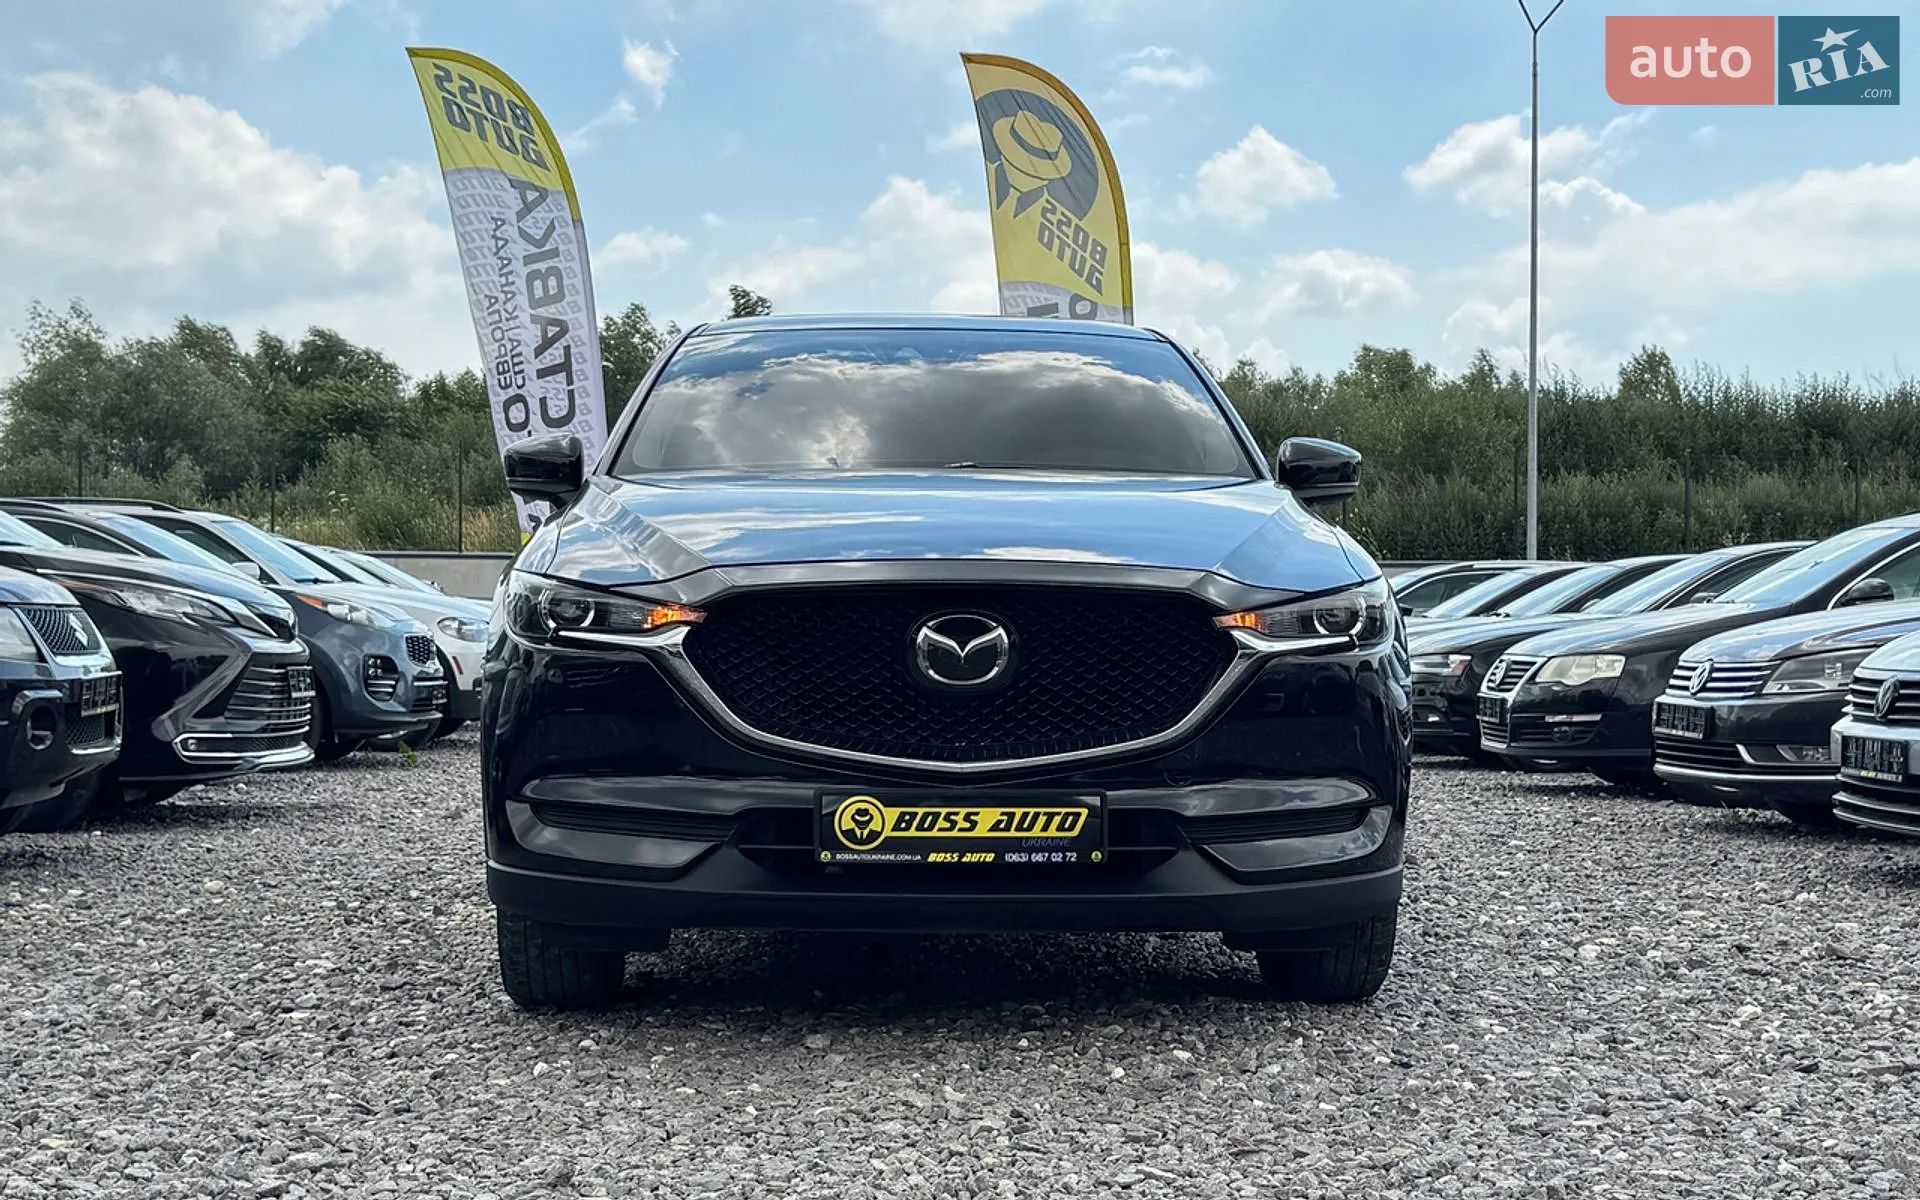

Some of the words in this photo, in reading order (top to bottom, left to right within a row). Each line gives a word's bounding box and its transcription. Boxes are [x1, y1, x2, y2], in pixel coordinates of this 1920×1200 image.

[891, 811, 980, 832] BOSS
[987, 811, 1083, 832] AUTO
[1021, 838, 1071, 848] UKRAINE
[927, 852, 960, 862] BOSS
[961, 852, 995, 862] AUTO
[1004, 852, 1029, 862] (063)
[1031, 852, 1049, 862] 667
[1051, 852, 1063, 862] 02
[1066, 852, 1078, 862] 72
